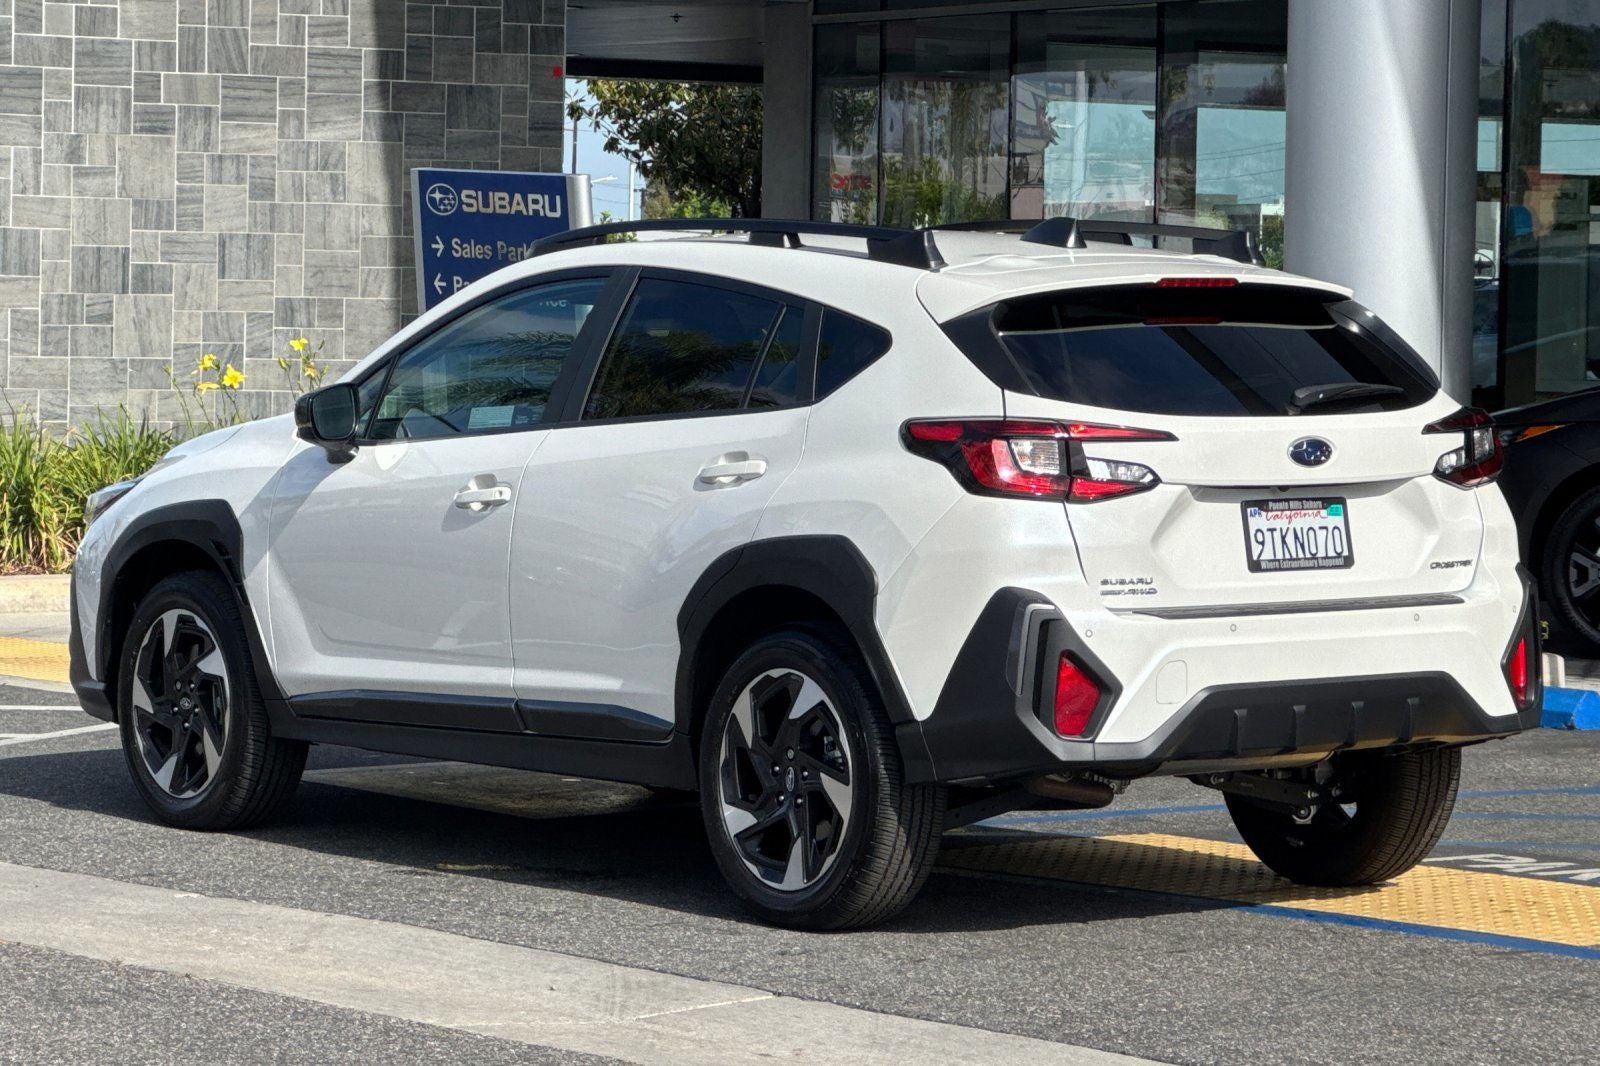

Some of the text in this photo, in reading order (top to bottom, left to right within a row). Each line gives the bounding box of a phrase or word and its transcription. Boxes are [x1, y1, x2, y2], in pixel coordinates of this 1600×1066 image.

[460, 190, 561, 217] SUBARU
[451, 238, 531, 261] Sales Park
[1265, 510, 1328, 525] California
[1254, 525, 1344, 560] 9TKN070
